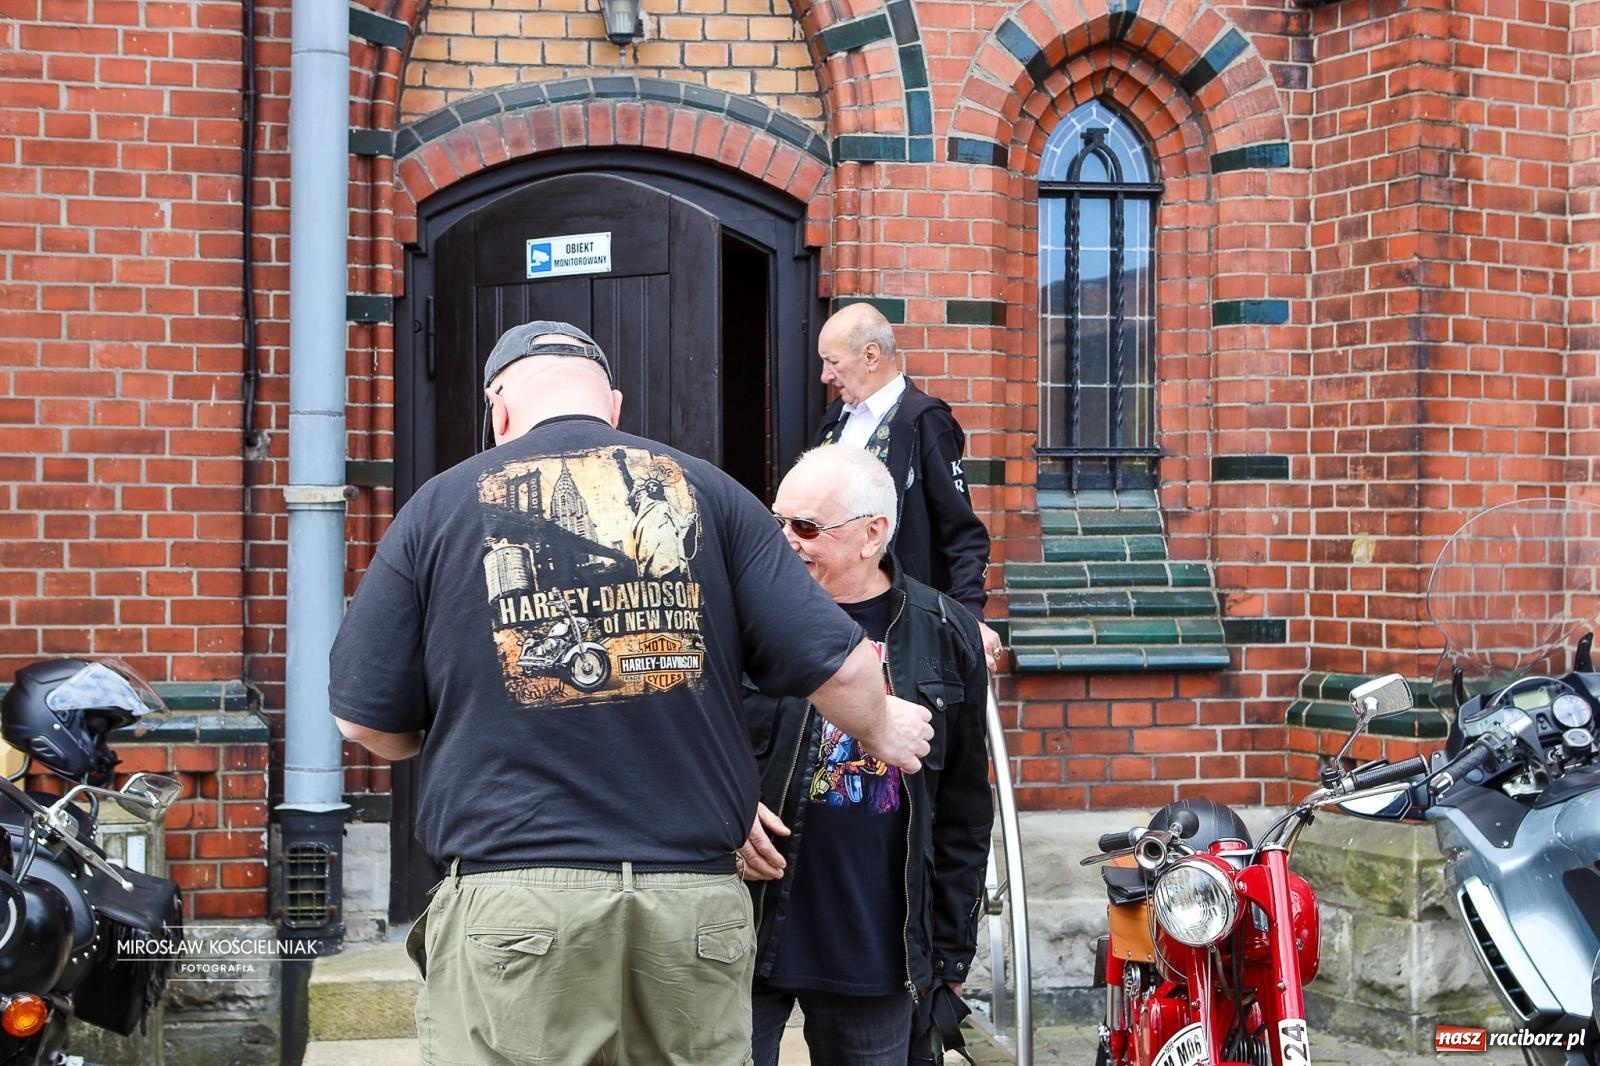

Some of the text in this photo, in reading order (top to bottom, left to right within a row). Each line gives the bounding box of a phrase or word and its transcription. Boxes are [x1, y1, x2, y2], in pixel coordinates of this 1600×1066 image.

[566, 242, 594, 254] OBIEKT
[554, 255, 607, 268] MONITOROWANY
[500, 580, 700, 625] HARLEY-DAVIDSON
[603, 609, 700, 634] of NEW YORK
[644, 638, 677, 652] MOTOR
[621, 655, 699, 673] HARLEY-DAVIDSON
[647, 673, 682, 687] CYCLES
